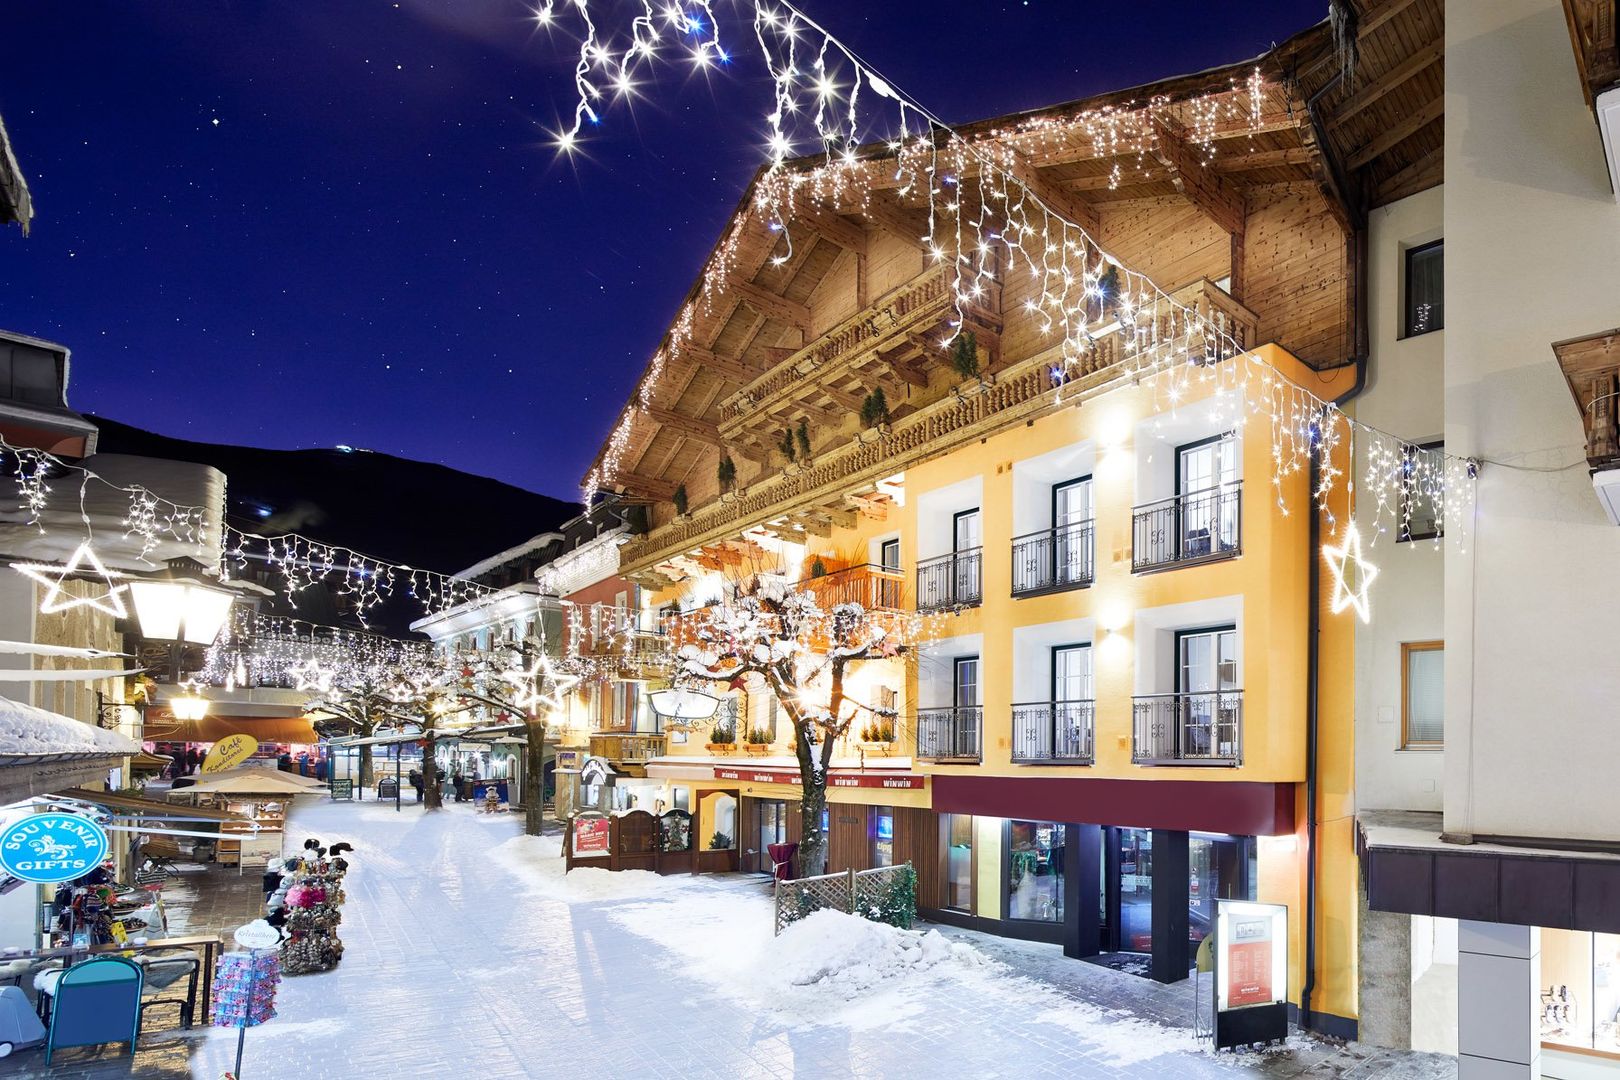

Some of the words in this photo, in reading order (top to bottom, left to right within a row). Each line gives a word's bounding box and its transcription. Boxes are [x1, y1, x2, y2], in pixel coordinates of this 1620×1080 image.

[220, 736, 242, 755] Café
[5, 820, 98, 850] SOUVENIR
[16, 859, 86, 870] GIFTS
